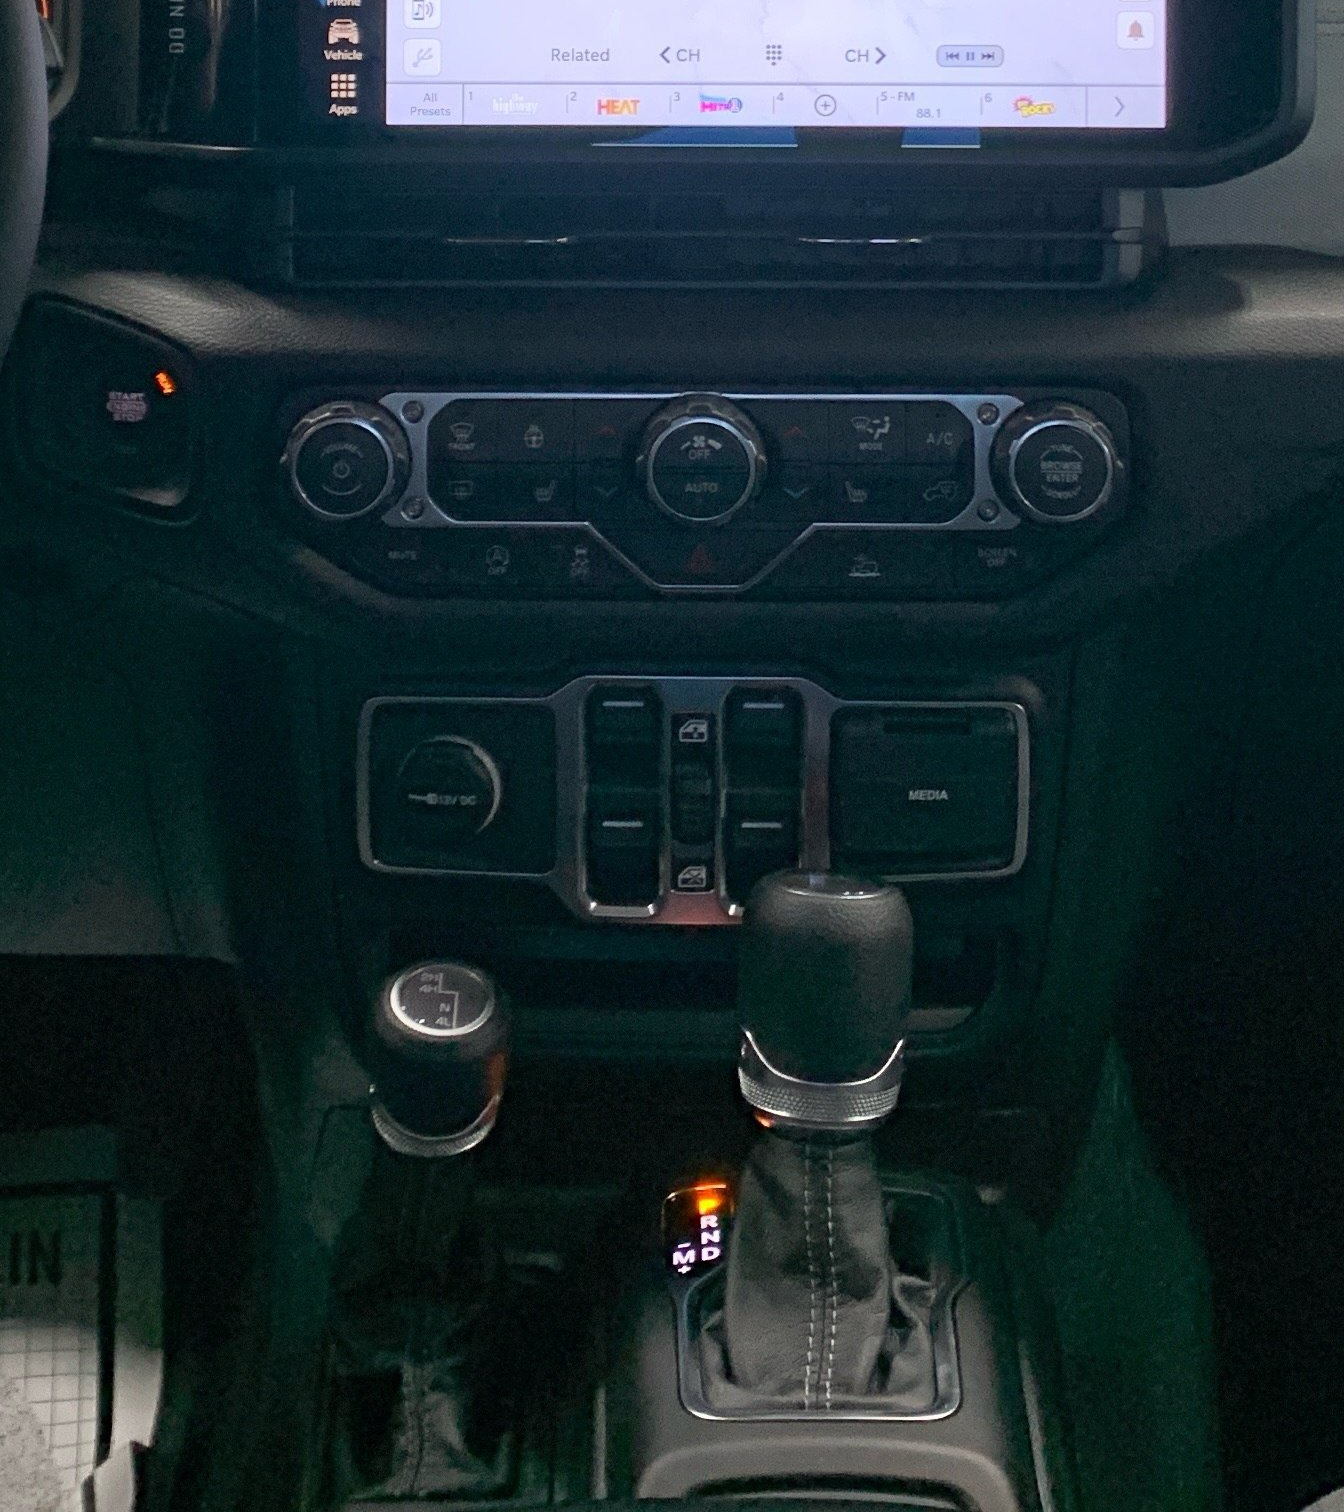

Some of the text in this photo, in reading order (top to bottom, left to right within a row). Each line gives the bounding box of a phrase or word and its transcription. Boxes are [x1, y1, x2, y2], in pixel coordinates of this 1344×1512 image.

[168, 27, 186, 54] DO
[323, 49, 363, 61] Vehicle
[551, 47, 611, 62] Related
[676, 48, 701, 62] CH
[844, 49, 870, 63] CH
[423, 92, 438, 102] All
[570, 91, 577, 102] 2
[673, 91, 681, 102] 3
[775, 92, 785, 102] 4
[880, 91, 888, 102] 5
[897, 91, 915, 102] FM
[984, 92, 993, 103] 6
[328, 103, 358, 116] Apps
[410, 106, 452, 117] Presets
[596, 98, 641, 115] HEAT
[915, 108, 942, 120] 88.1
[926, 432, 954, 446] A/C
[687, 448, 711, 461] OFF
[684, 482, 719, 494] AUTO
[907, 788, 949, 801] MEDIA
[699, 1214, 719, 1230] R
[700, 1229, 722, 1246] N
[9, 1228, 63, 1288] IN
[672, 1249, 696, 1266] M
[701, 1246, 722, 1262] D
